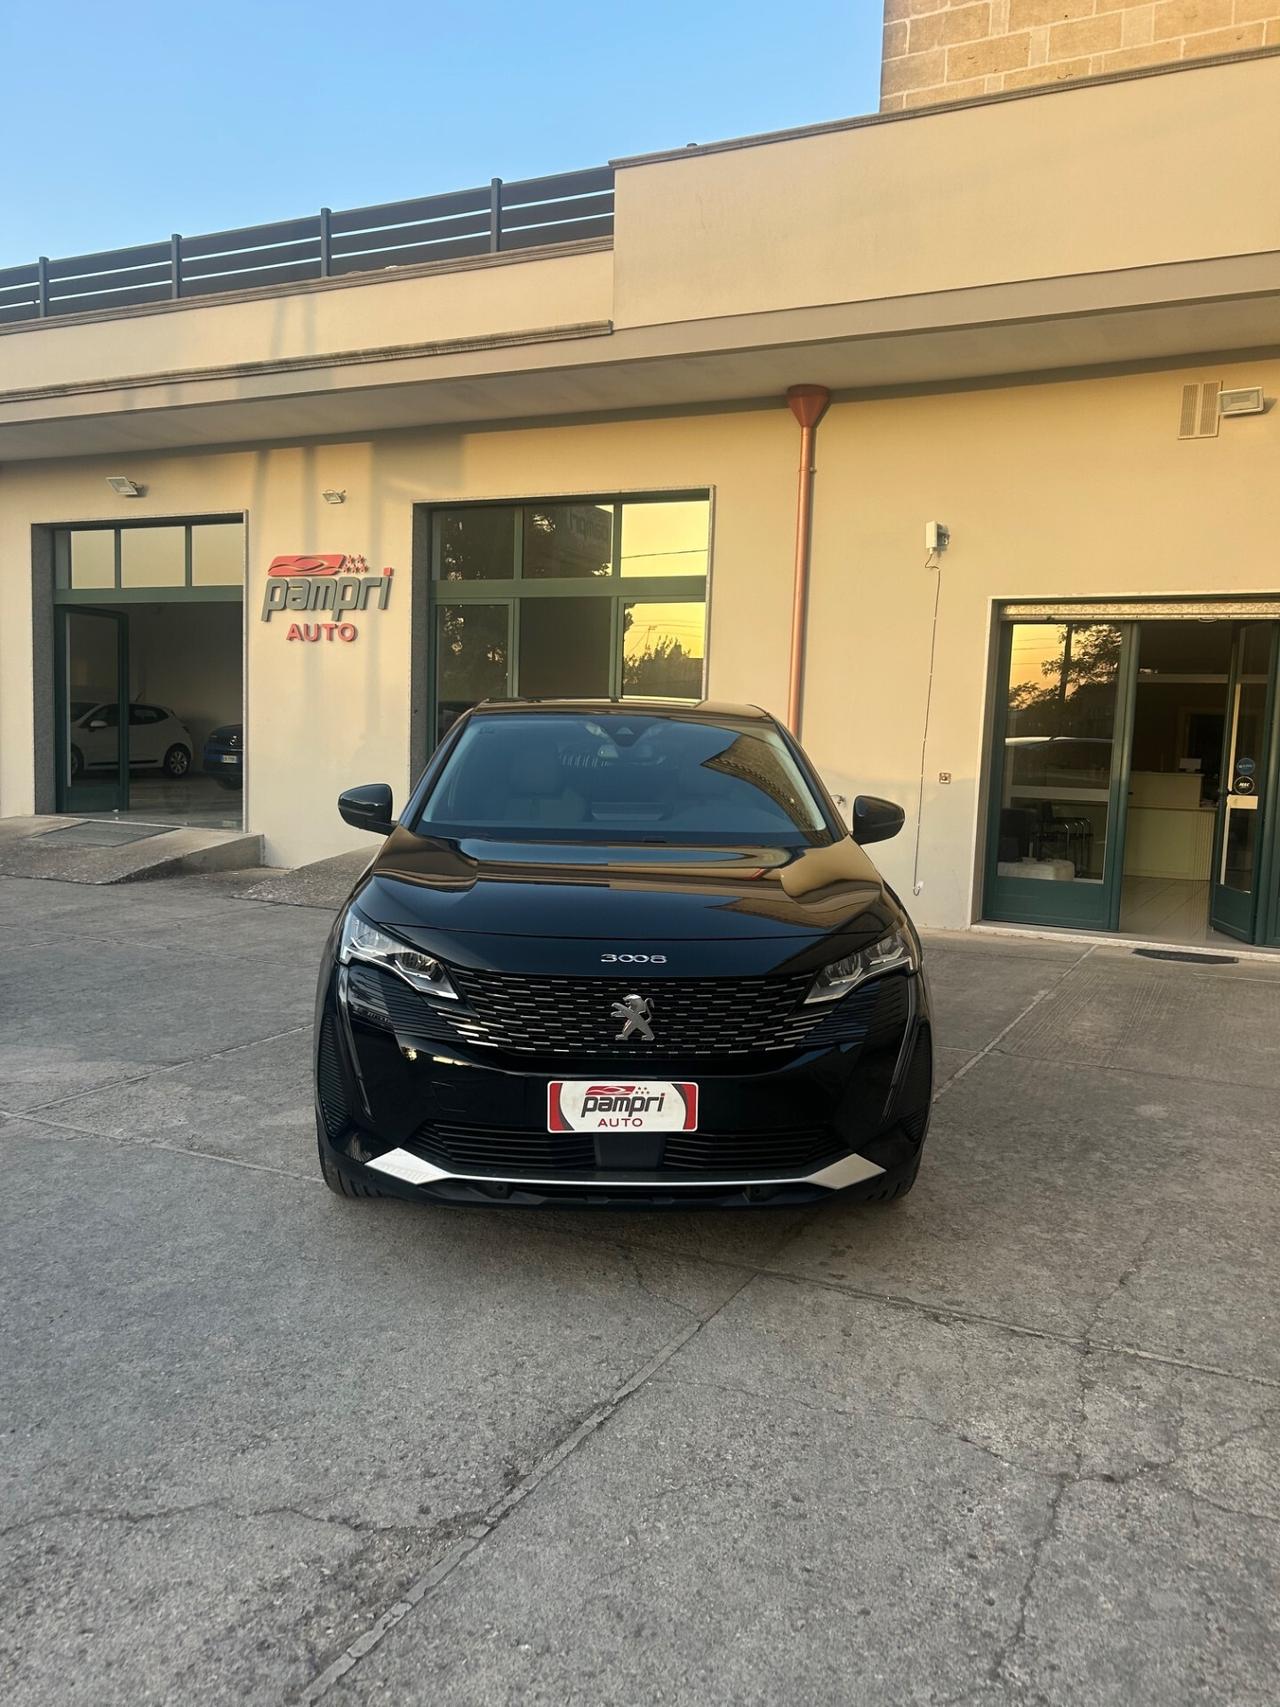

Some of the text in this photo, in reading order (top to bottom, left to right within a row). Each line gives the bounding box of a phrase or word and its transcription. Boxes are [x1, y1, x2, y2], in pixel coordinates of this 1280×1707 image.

[261, 567, 393, 622] pampri
[286, 622, 357, 642] AUTO
[600, 953, 667, 964] 3008
[580, 1092, 666, 1118] pampri
[597, 1118, 643, 1128] AUTO
